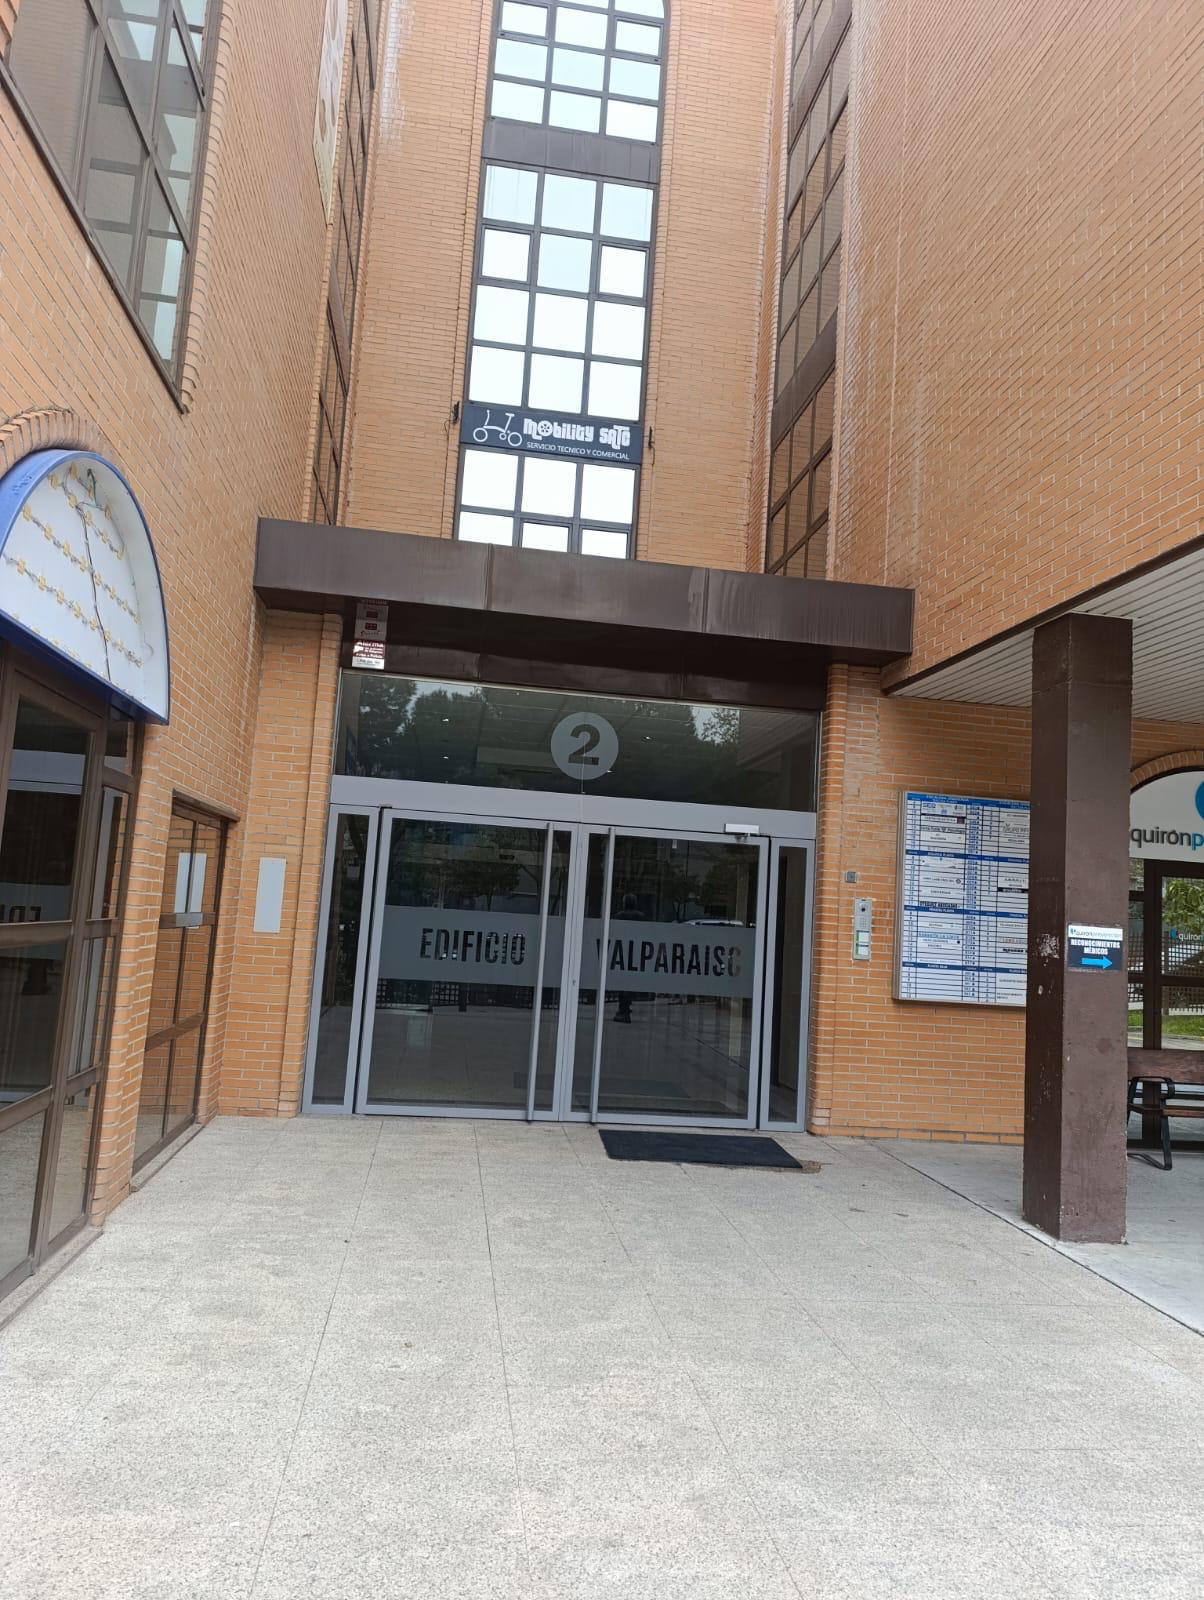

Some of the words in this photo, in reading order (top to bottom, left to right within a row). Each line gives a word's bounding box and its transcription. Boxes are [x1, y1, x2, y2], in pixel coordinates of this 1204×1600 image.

[526, 442, 556, 451] SERVICIO
[592, 449, 630, 460] COMERCIAL
[568, 723, 601, 766] 2
[420, 927, 526, 966] EDIFICIO
